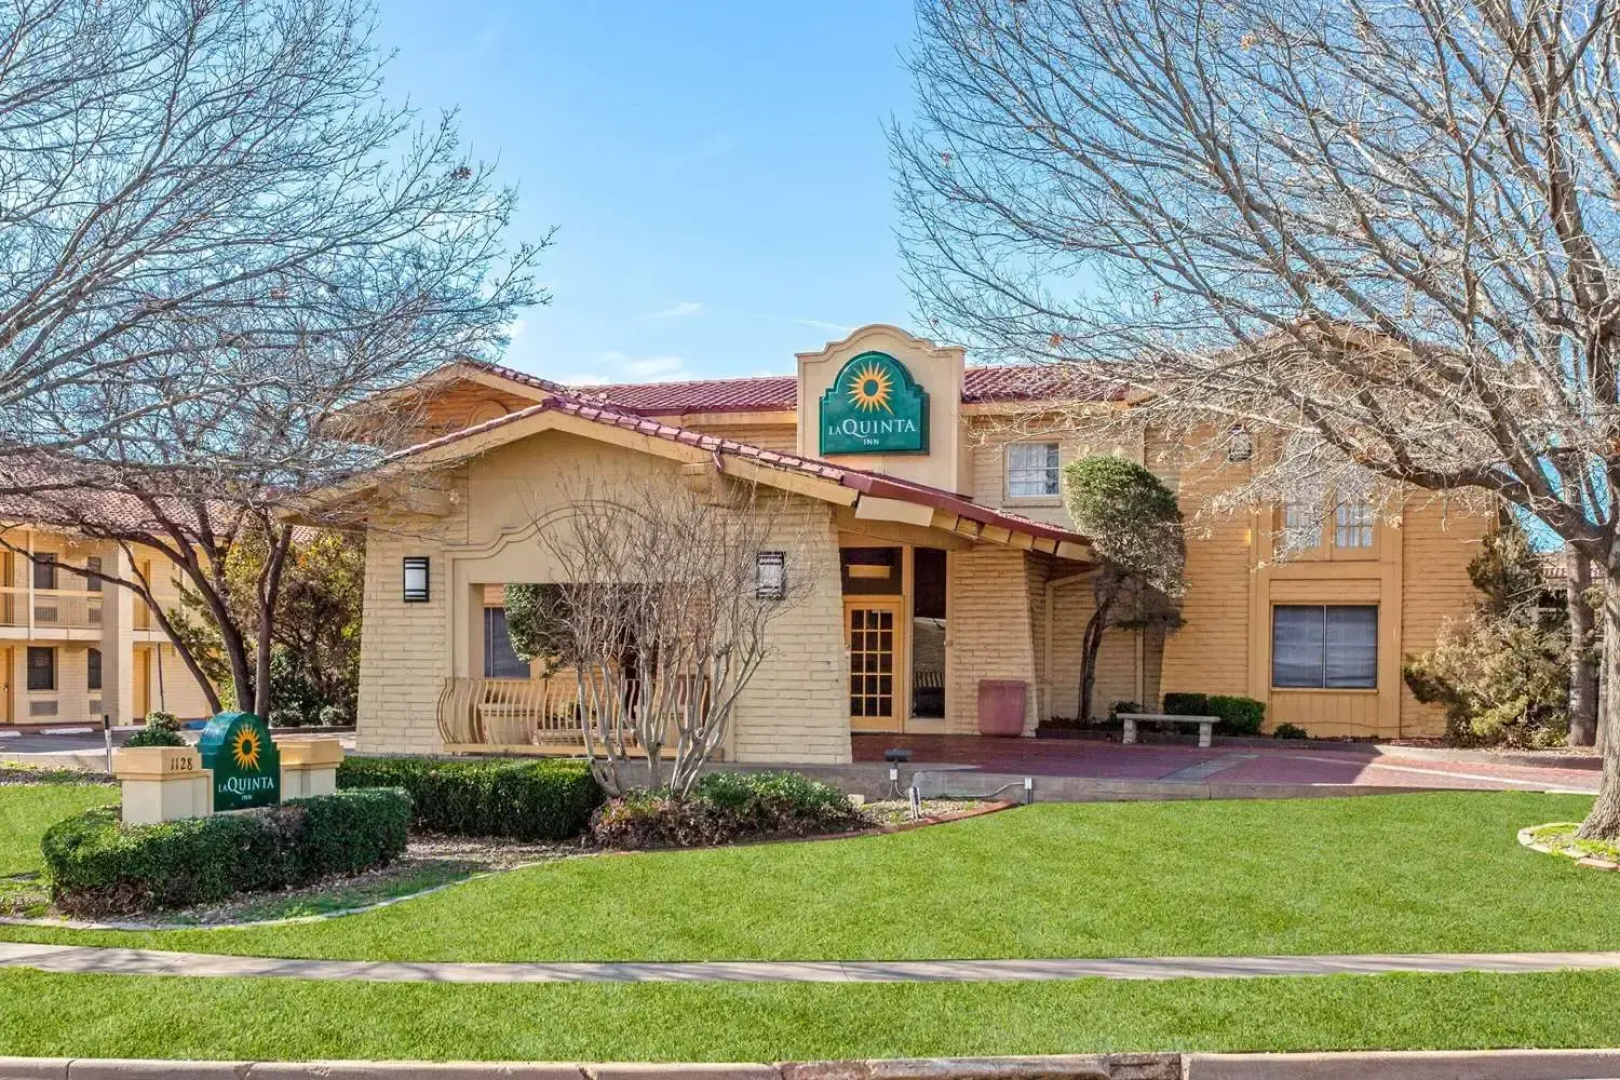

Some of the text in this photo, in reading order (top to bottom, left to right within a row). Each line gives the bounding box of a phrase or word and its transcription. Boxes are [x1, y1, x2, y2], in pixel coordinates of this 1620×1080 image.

[828, 418, 917, 438] LA QUINTA
[863, 438, 880, 446] INN
[170, 757, 193, 771] 1128
[218, 776, 274, 795] LA QUINTA
